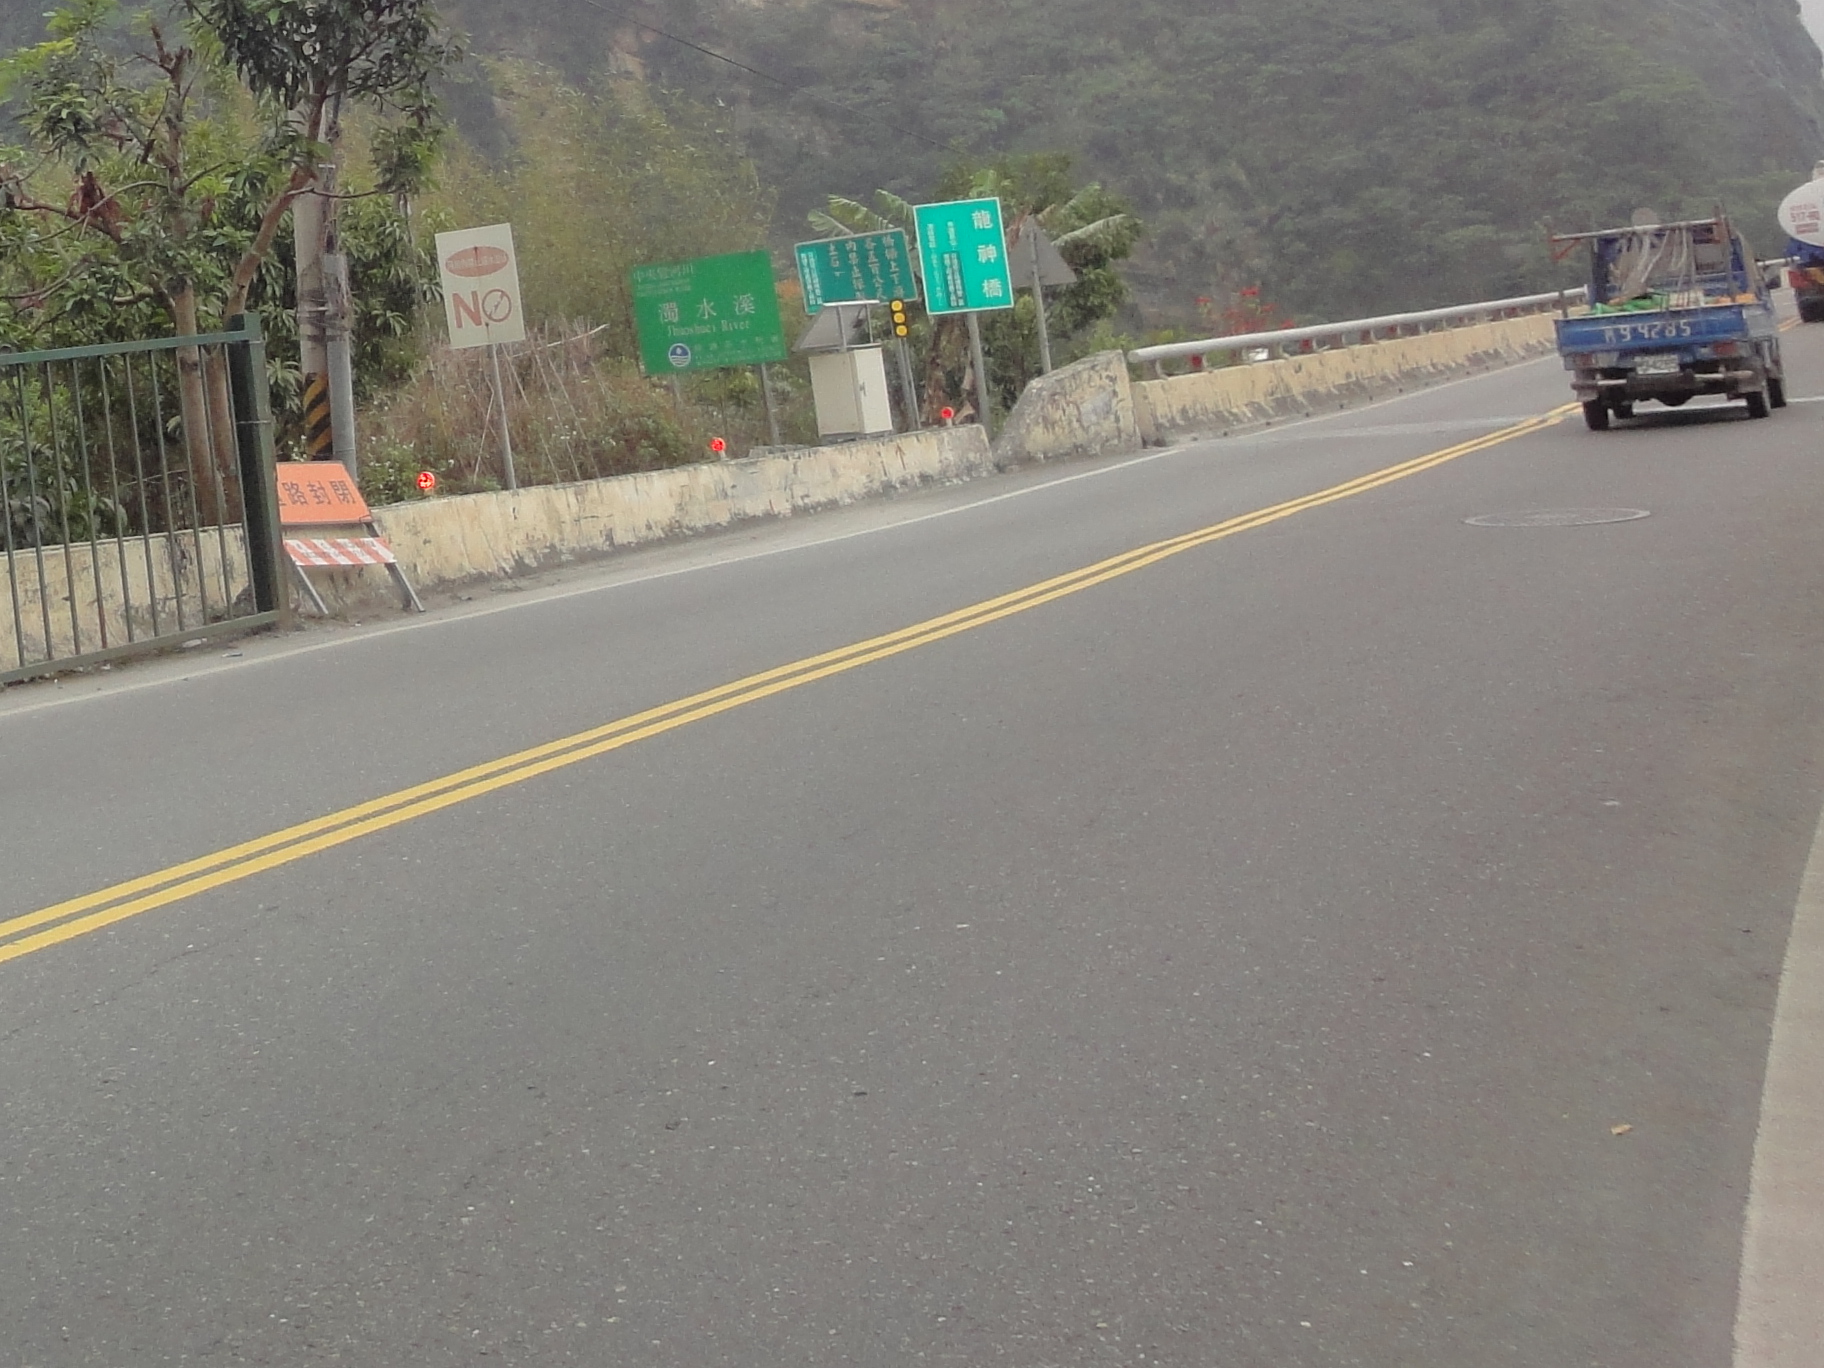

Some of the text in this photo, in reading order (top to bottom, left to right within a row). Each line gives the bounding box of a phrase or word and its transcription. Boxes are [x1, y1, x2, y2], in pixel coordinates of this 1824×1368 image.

[972, 210, 1003, 298] 龍神橋
[659, 293, 756, 324] 濁水溪
[721, 319, 751, 332] River
[279, 480, 356, 506] 路封閉
